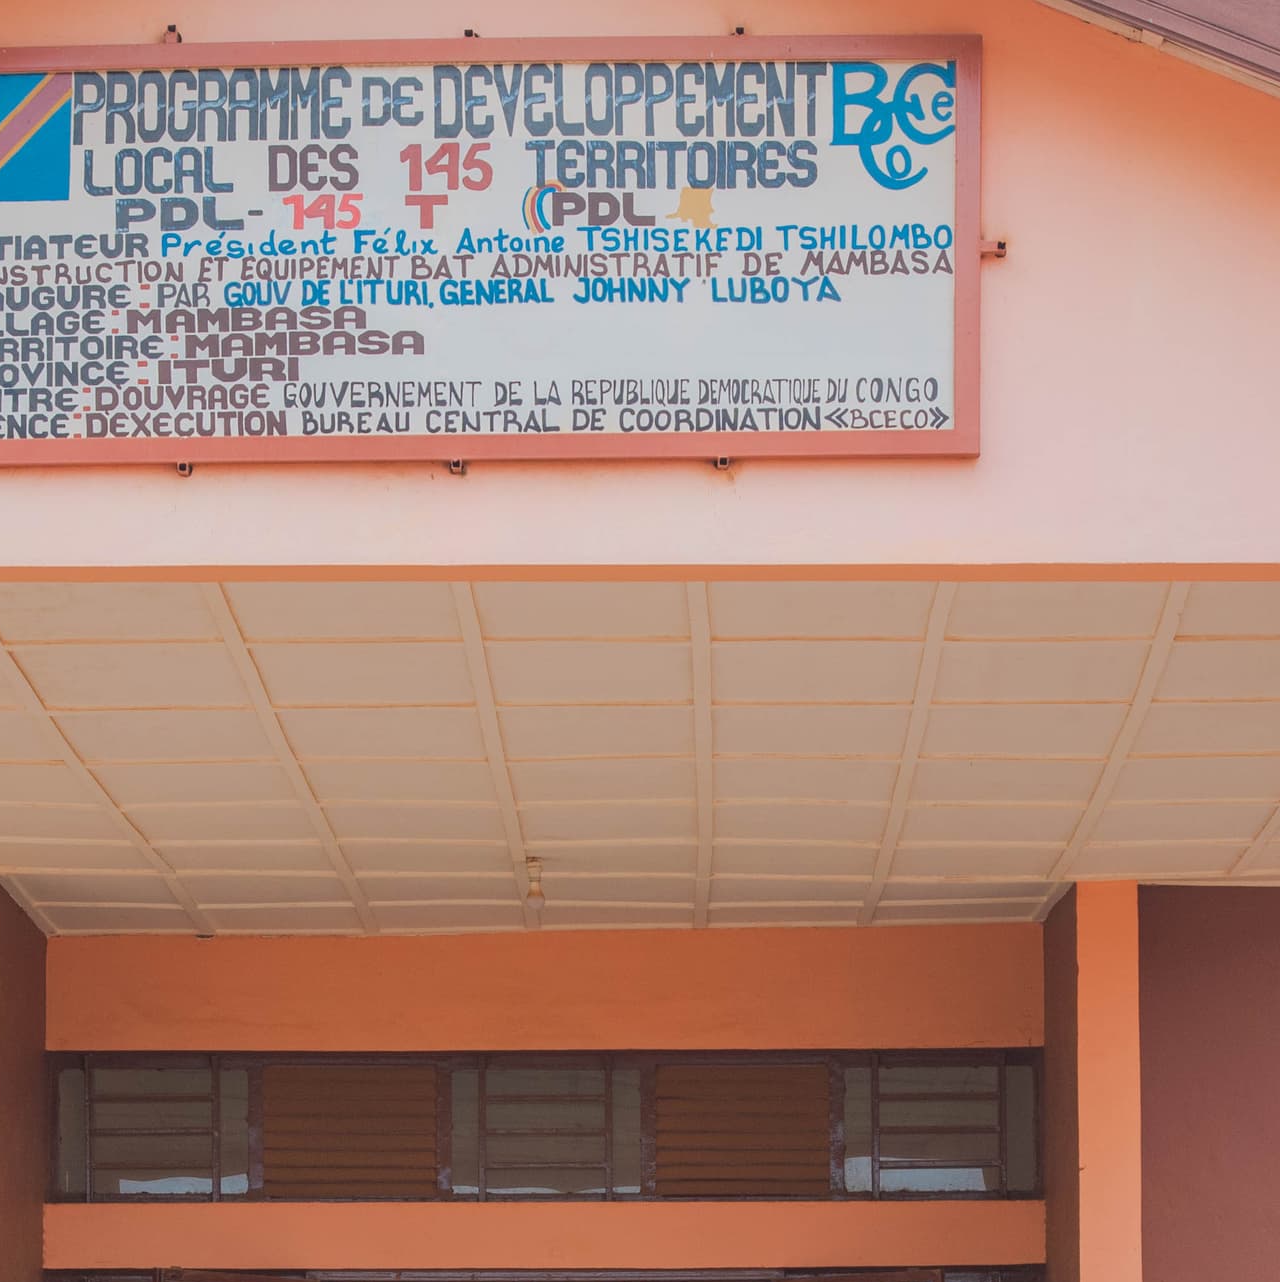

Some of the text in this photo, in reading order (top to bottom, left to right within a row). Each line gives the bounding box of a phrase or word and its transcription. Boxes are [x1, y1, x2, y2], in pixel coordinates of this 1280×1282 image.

[73, 61, 827, 145] PROGRAMME DE DEVELOPPEMENT
[84, 140, 818, 196] LOCAL DES 145 TERRITOIRES
[283, 193, 364, 230] 145
[404, 193, 448, 229] T
[552, 191, 656, 227] PDL
[161, 229, 336, 259] Président
[354, 227, 438, 255] Félix
[456, 227, 565, 253] Antoine
[577, 225, 762, 251] TSHISEKEDI
[776, 224, 953, 251] TSHILOMBO
[198, 256, 229, 282] ET
[240, 255, 400, 281] EQUIPEMENT
[410, 253, 474, 280] BAT
[490, 252, 722, 279] ADMINISTRATIF
[742, 252, 783, 277] DE
[800, 249, 953, 276] MAMBASA
[157, 282, 210, 308] PAR
[223, 281, 292, 309] GOUV
[301, 279, 331, 307] DE
[439, 278, 555, 307] GENERAL
[573, 277, 690, 304] JOHNNY
[711, 276, 842, 304] LUBOYA
[126, 306, 366, 334] MAMBASA
[185, 330, 424, 358] MAMBASA
[158, 357, 299, 384] ITURI
[283, 381, 482, 408] GOUVERNEMENT
[495, 381, 521, 407] DE
[534, 380, 561, 405] LA
[571, 378, 690, 406] REPUBLIQUE
[698, 378, 821, 405] DEMOCRATIQUE
[826, 377, 848, 404] DU
[856, 377, 938, 403] CONGO
[302, 410, 410, 435] BUREAU
[425, 408, 560, 434] CENTRAL
[572, 408, 607, 431] DE
[619, 406, 821, 432] COORDINATION
